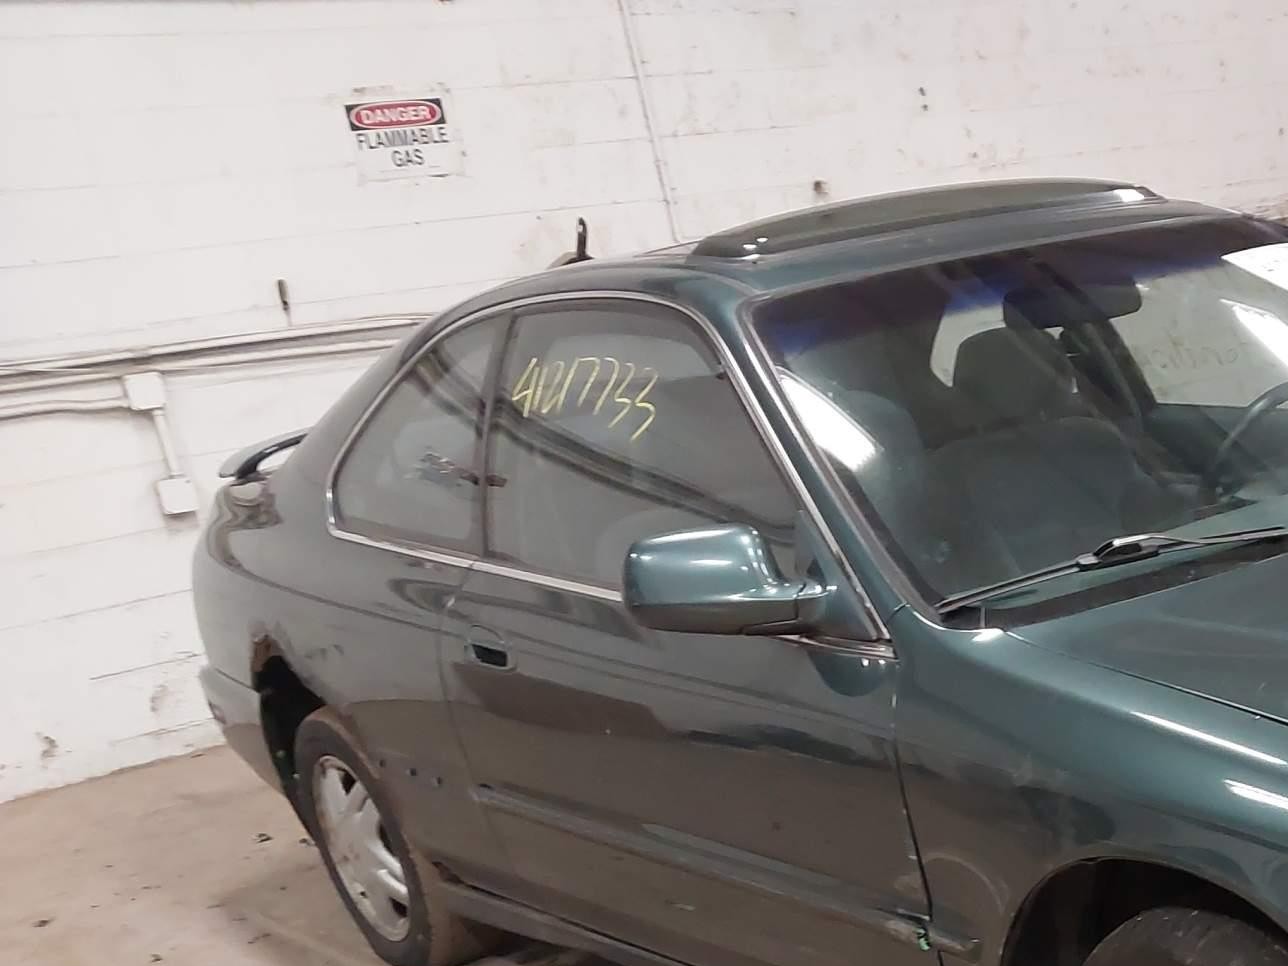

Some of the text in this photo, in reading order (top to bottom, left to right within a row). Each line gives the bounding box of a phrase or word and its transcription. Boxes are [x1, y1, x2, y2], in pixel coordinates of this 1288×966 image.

[360, 105, 432, 125] DANGER
[356, 126, 449, 150] FLAMMABLE
[391, 149, 425, 167] GAS
